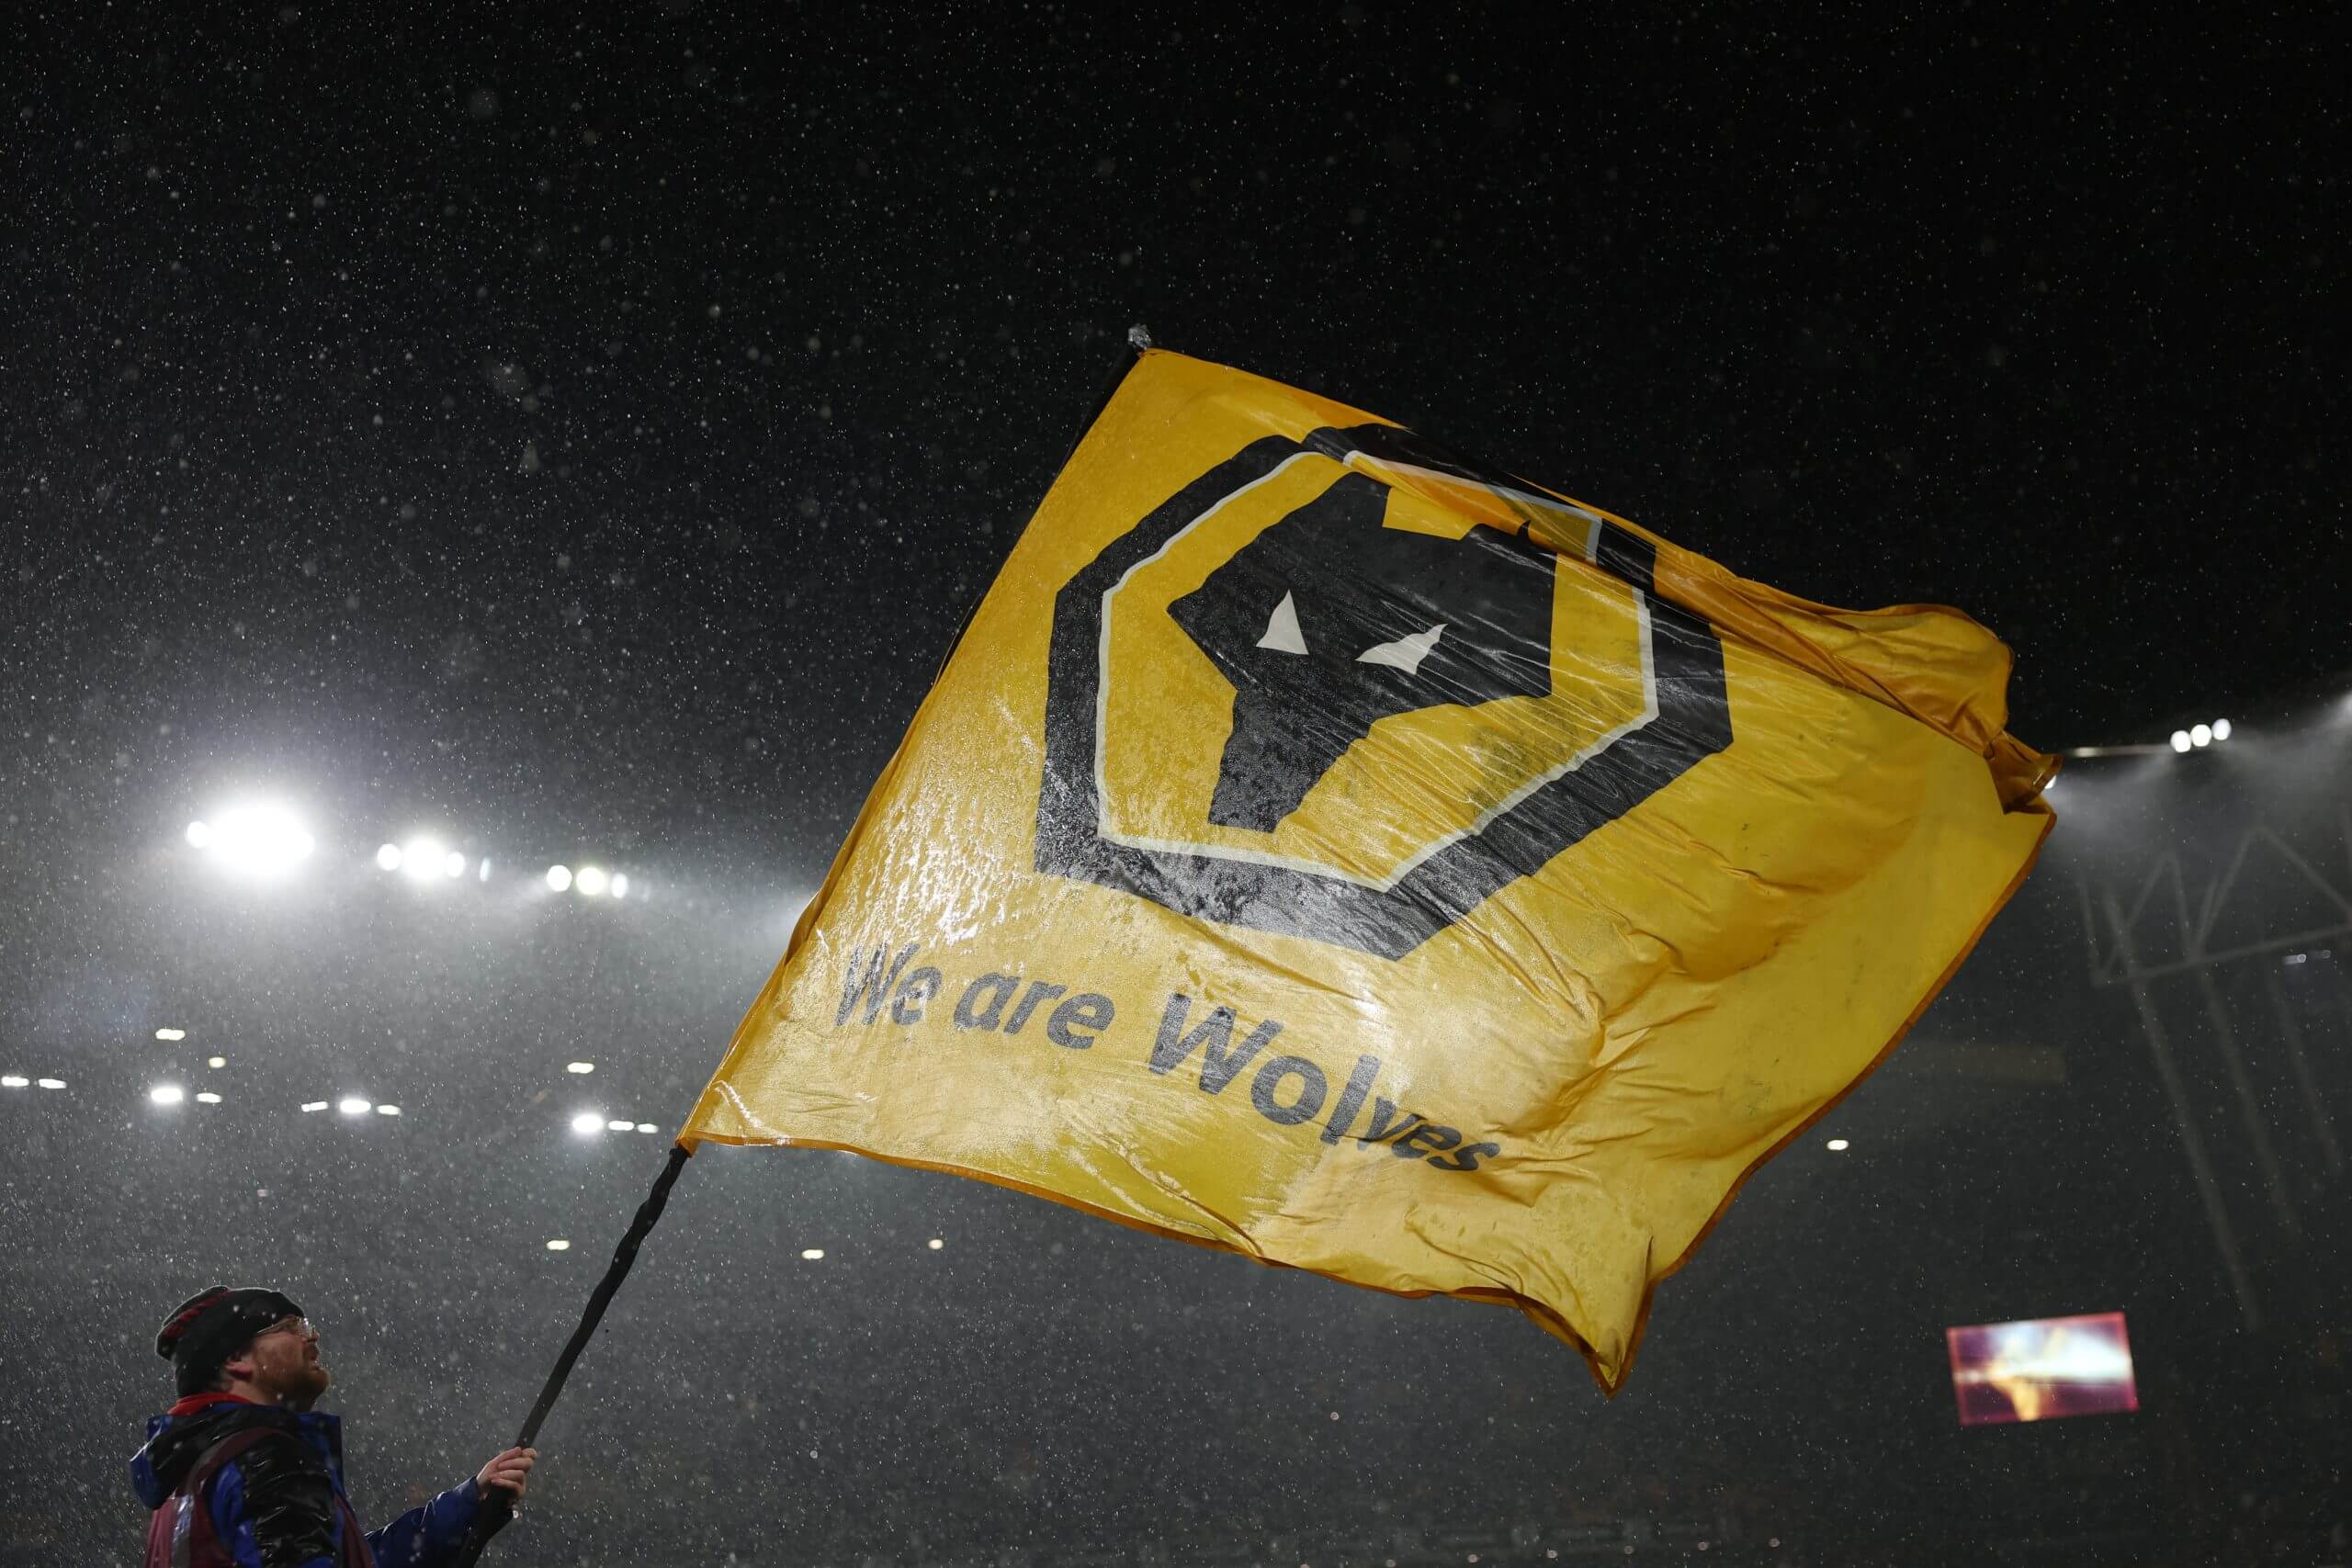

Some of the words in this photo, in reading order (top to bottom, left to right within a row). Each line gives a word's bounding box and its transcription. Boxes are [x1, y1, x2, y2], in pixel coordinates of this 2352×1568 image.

[835, 943, 942, 1026] We
[954, 972, 1115, 1049] are
[1148, 992, 1500, 1171] Wolves
